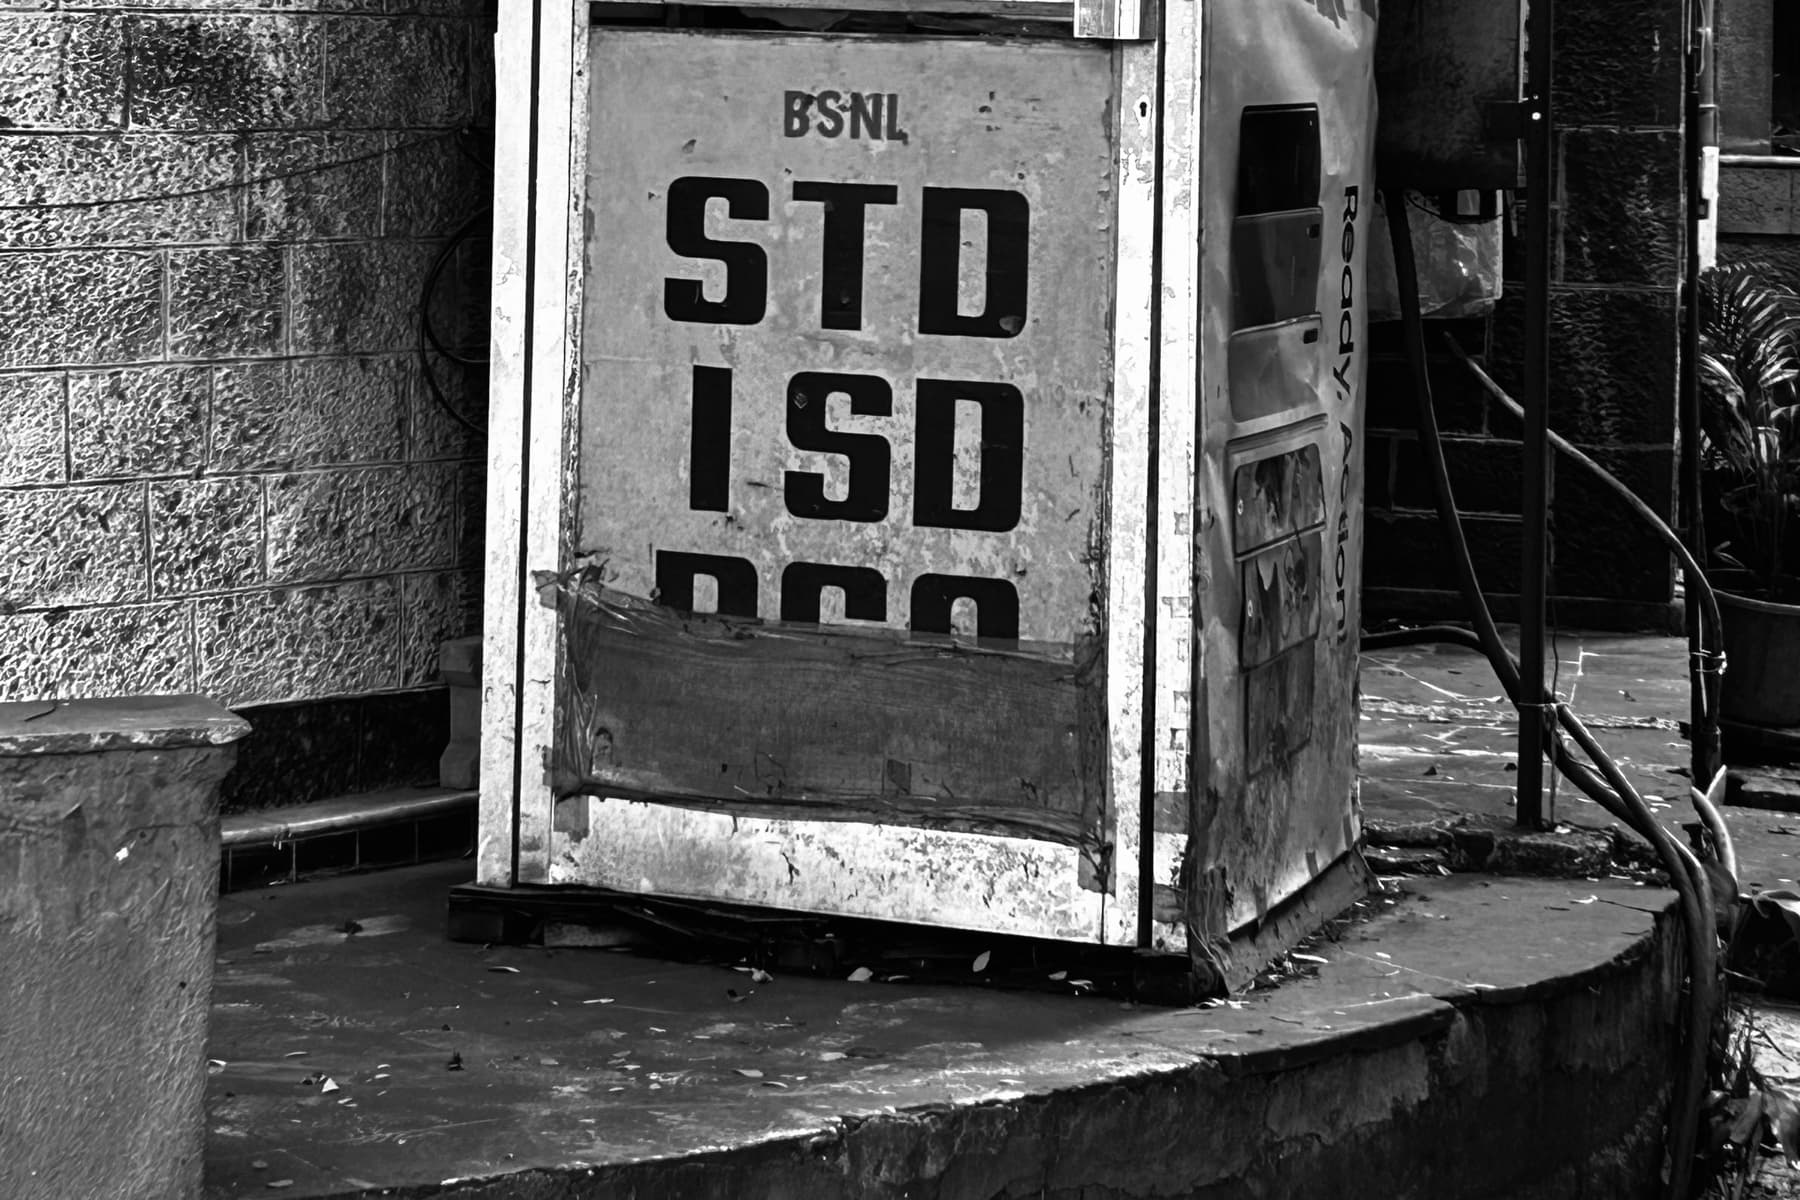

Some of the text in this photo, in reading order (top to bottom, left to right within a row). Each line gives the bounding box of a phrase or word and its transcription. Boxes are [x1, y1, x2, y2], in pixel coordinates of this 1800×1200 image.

[784, 90, 908, 142] BSNL
[664, 176, 1030, 338] STD
[690, 364, 1024, 532] ISD
